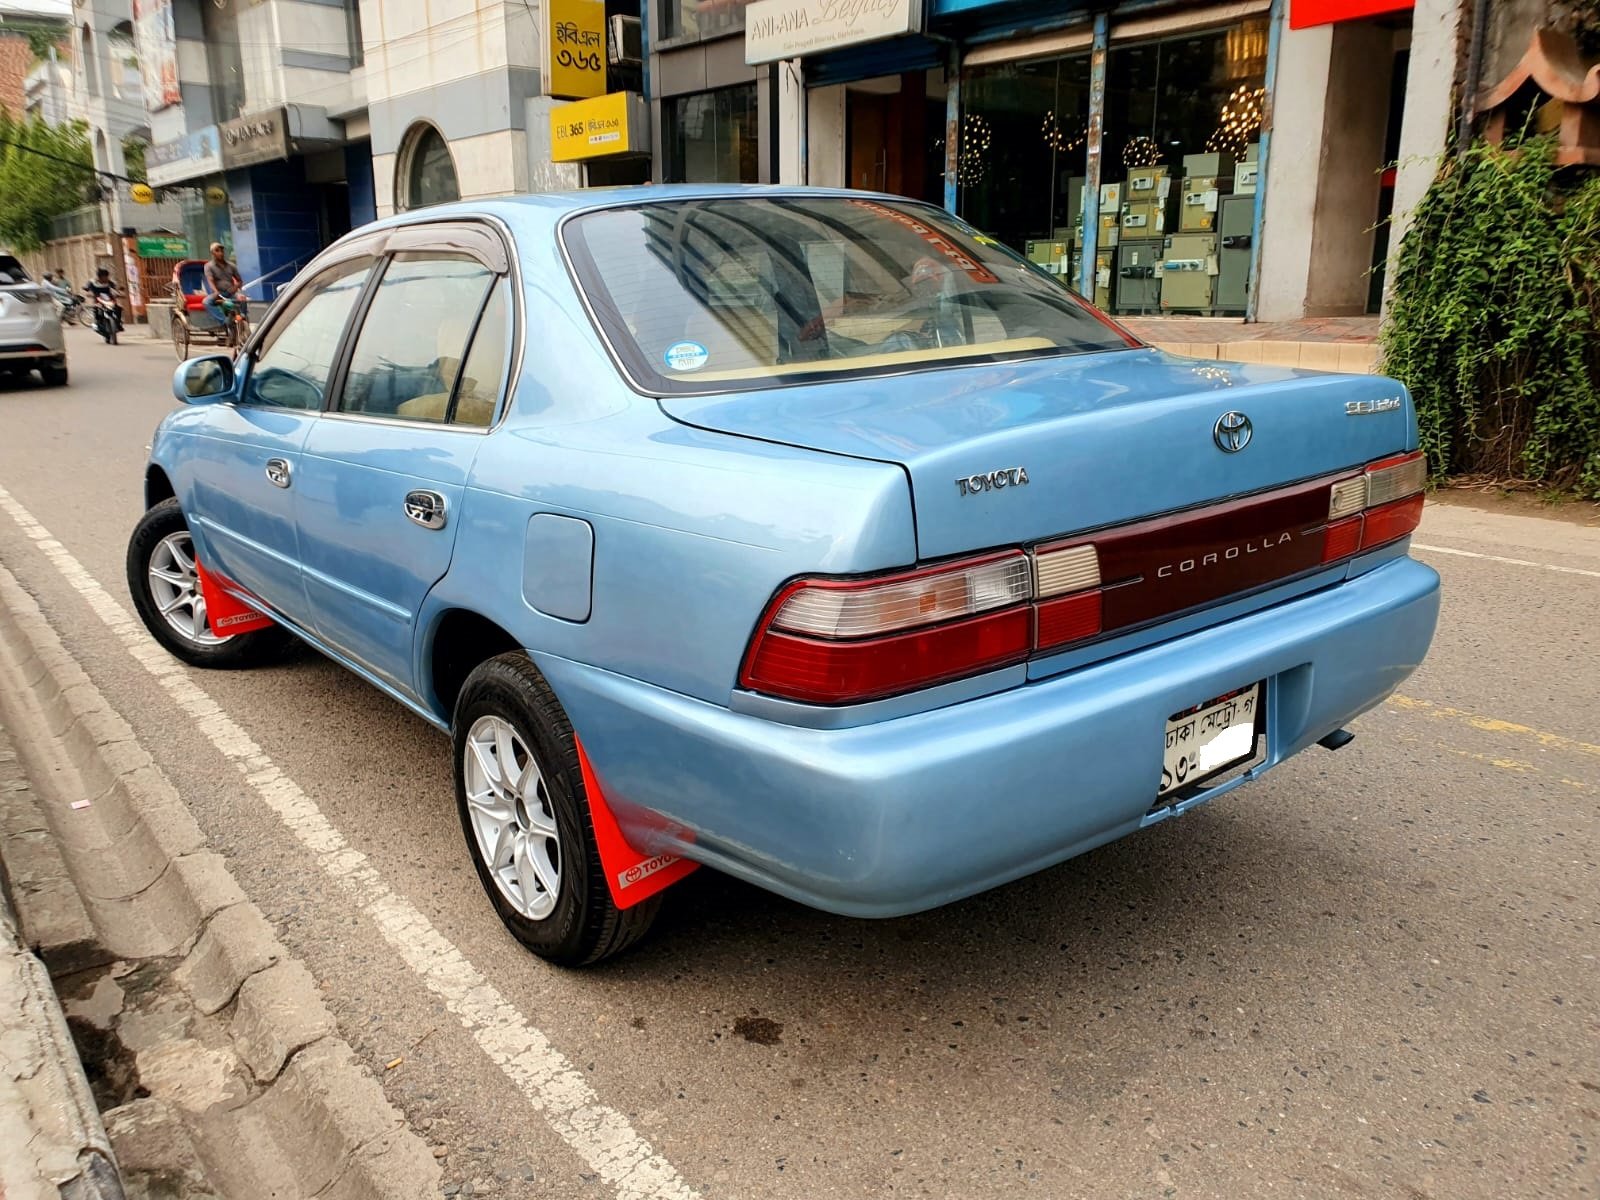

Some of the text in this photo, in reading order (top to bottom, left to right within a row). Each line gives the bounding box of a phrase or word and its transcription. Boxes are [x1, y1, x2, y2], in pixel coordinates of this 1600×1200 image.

[556, 22, 600, 48] ইবিএল
[556, 49, 601, 71] ৩৬৫
[569, 121, 584, 138] 365
[954, 466, 1030, 497] TOYOTA
[1157, 531, 1292, 578] COROLLA
[1165, 719, 1196, 749] ঢাকা
